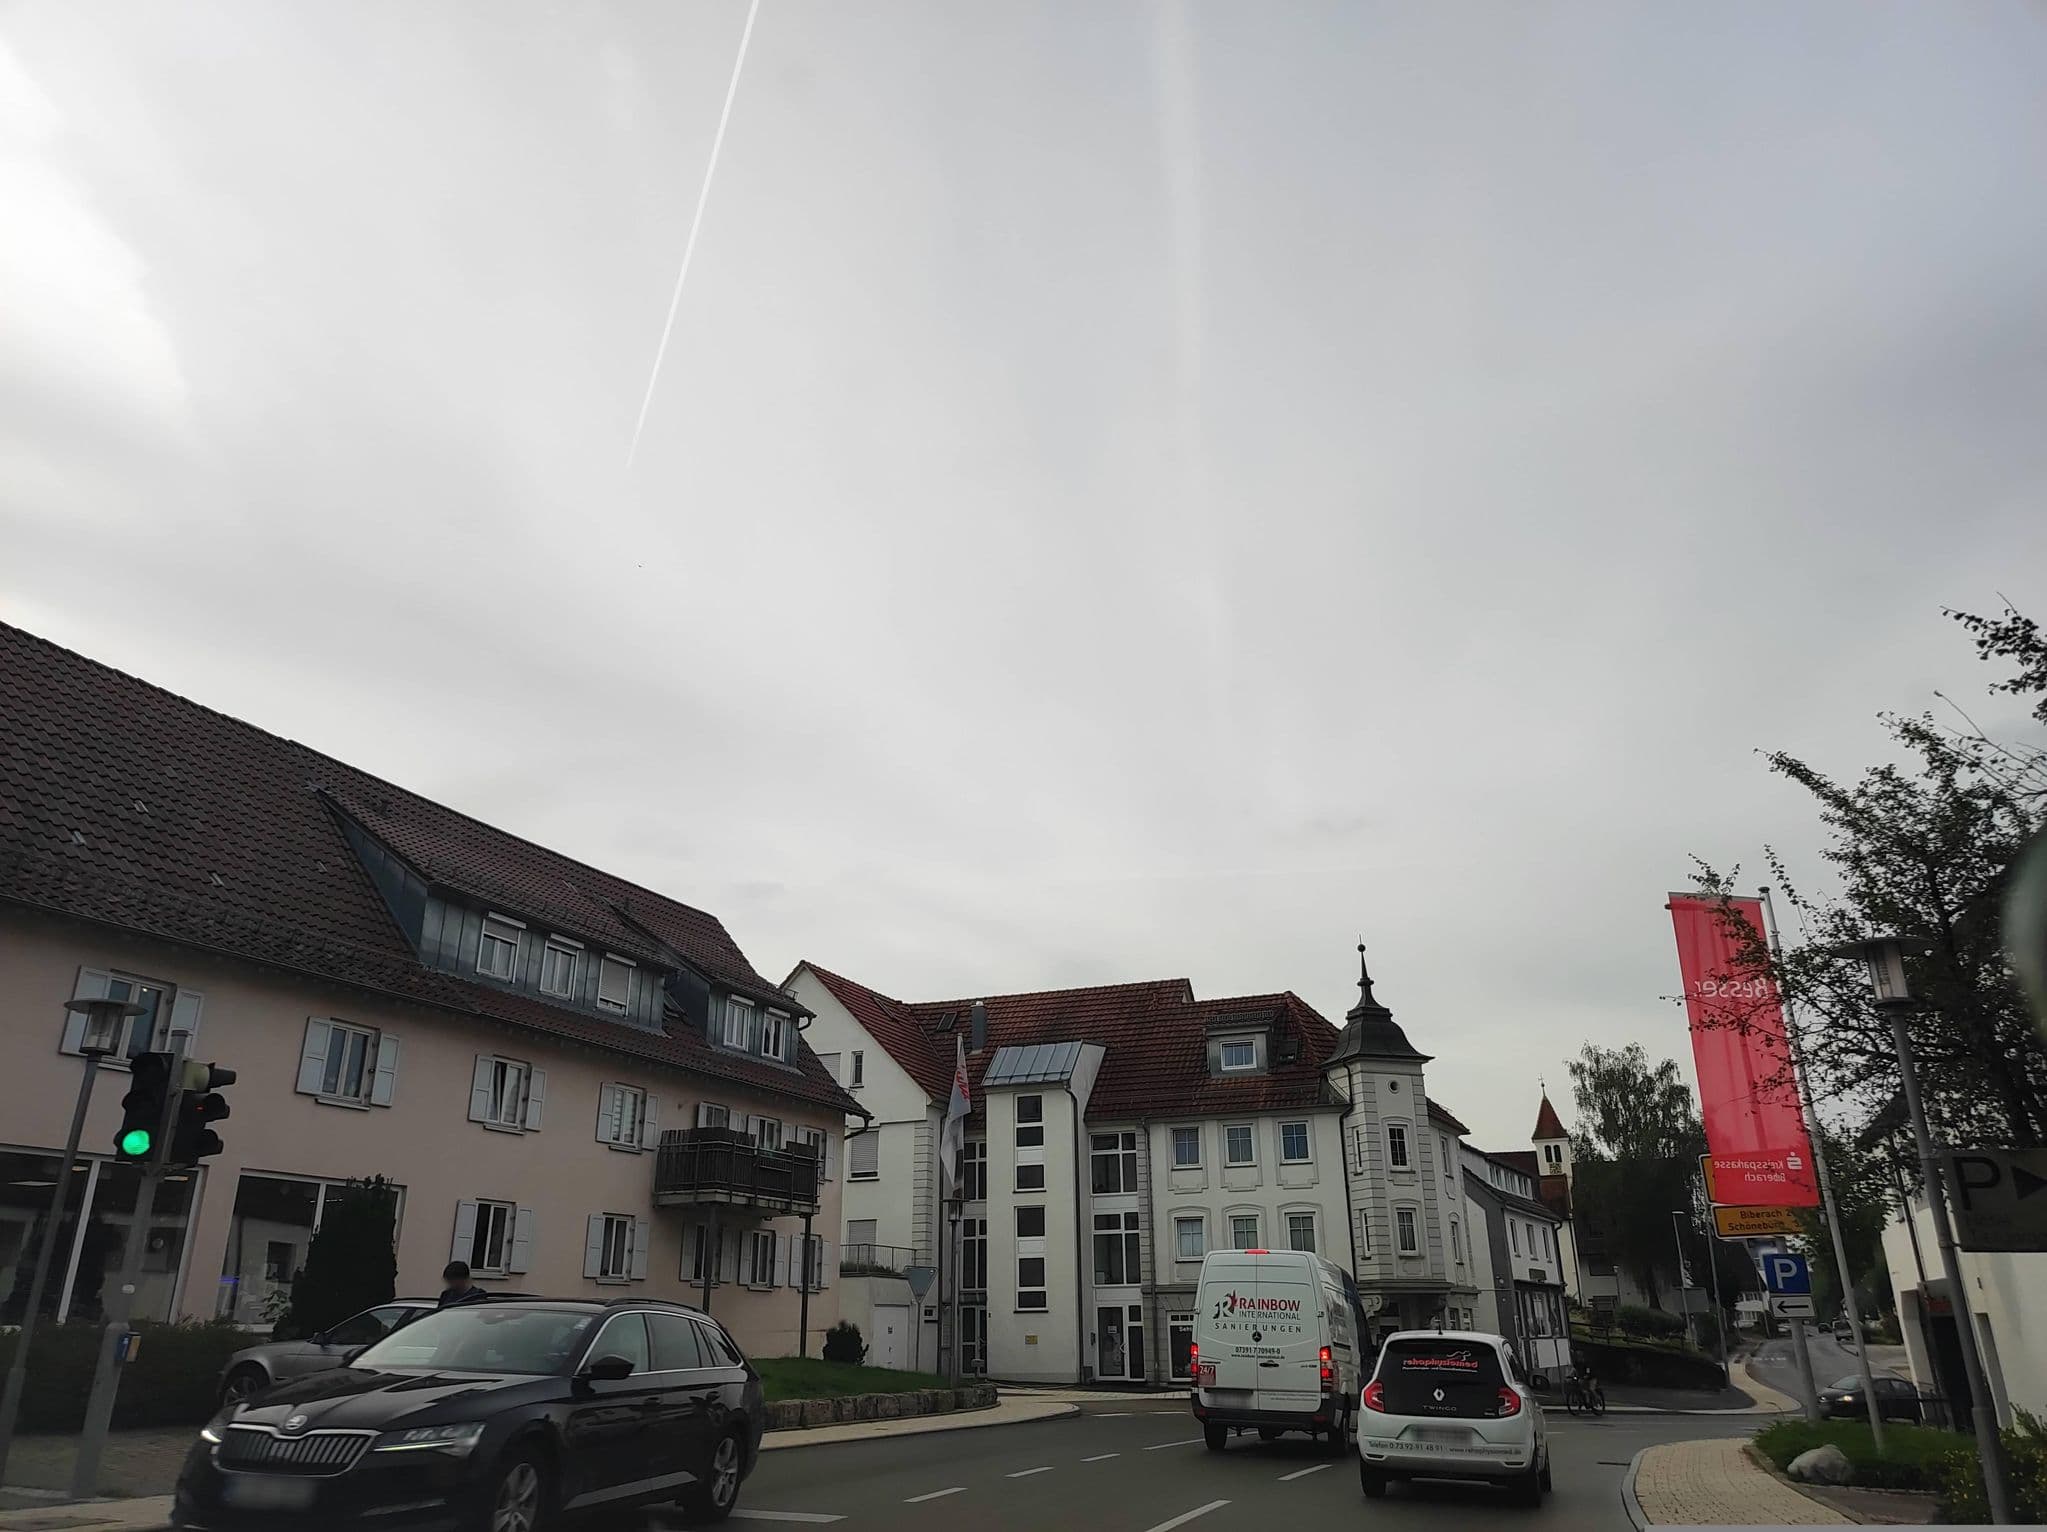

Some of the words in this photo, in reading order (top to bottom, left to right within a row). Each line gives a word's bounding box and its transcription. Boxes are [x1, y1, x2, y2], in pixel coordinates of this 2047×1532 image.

[1952, 1156, 2001, 1211] P
[1740, 1209, 1782, 1219] Biberach
[1773, 1258, 1798, 1289] P
[1239, 1298, 1301, 1312] RAINBOW
[1239, 1311, 1301, 1320] INTERNATIONAL
[1215, 1323, 1302, 1333] SANIERUNGEN
[1403, 1358, 1478, 1368] rehaphysiomed
[1199, 1365, 1215, 1375] 24/7
[1368, 1440, 1388, 1449] Telefon
